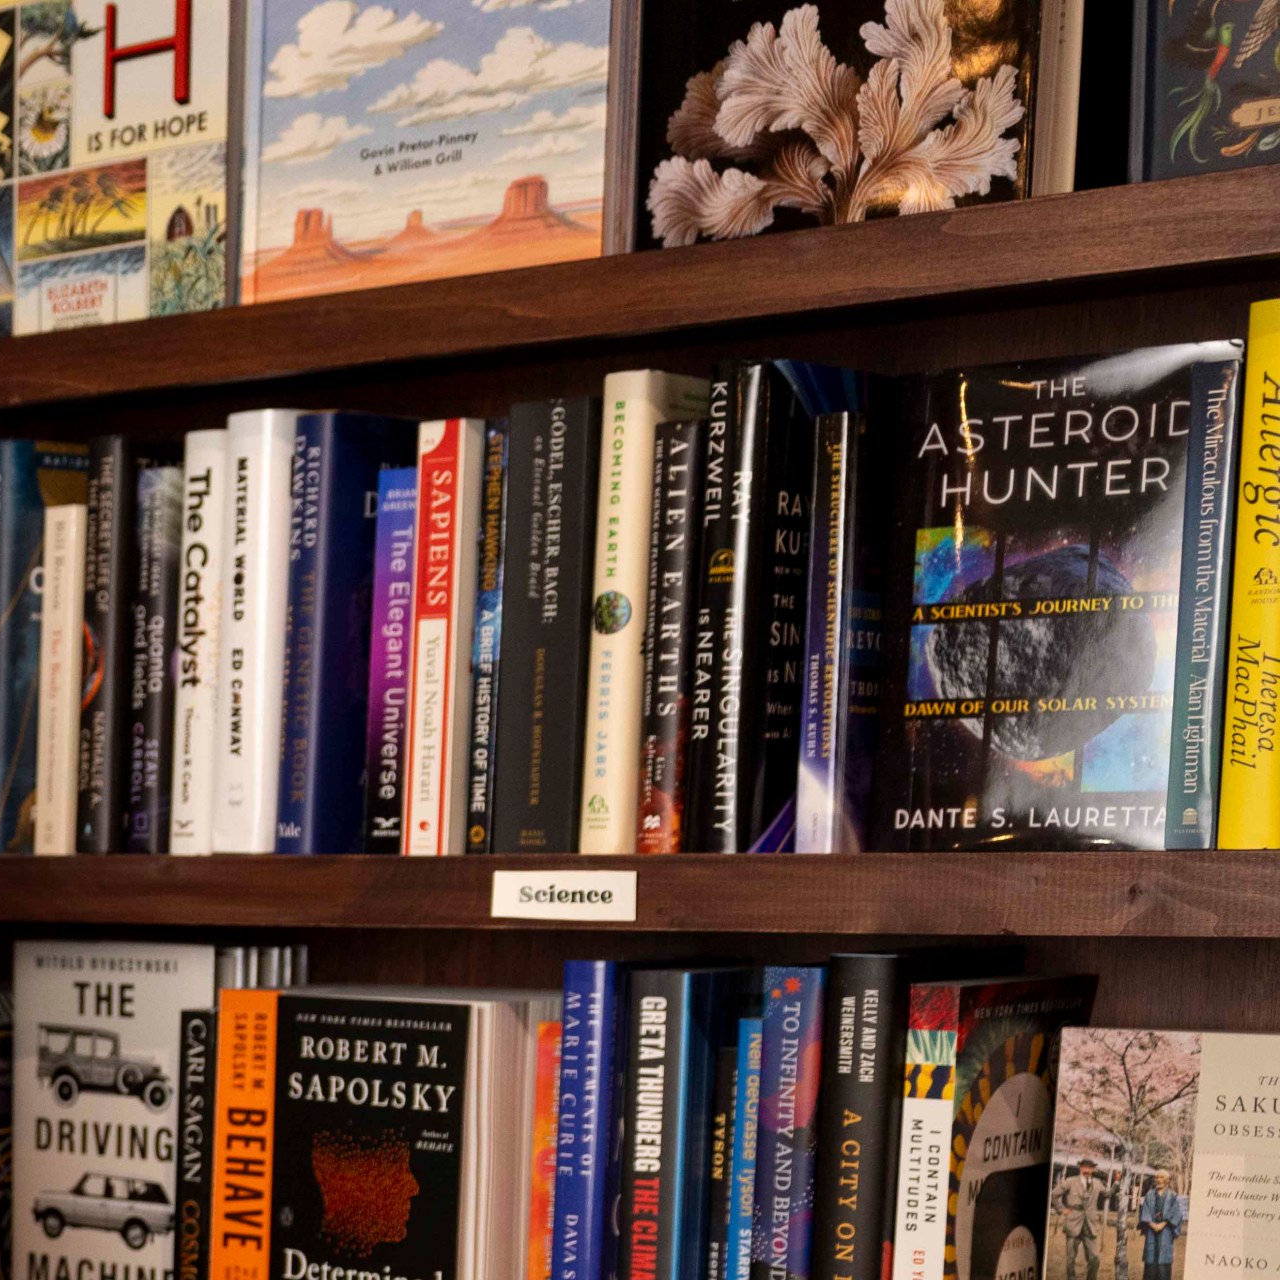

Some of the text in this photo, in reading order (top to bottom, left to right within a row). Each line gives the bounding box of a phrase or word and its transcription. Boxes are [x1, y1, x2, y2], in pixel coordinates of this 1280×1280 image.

[89, 112, 208, 152] IS FOR HOPE
[360, 130, 478, 161] Gavin Pretor-Pinney
[374, 150, 462, 175] & William Grill
[1033, 377, 1086, 400] THE
[705, 381, 729, 527] KURZWEIL
[942, 458, 1169, 509] HUNTER
[426, 469, 453, 607] SAPIENS
[656, 437, 690, 719] ALIEN EARTHS
[895, 805, 1167, 830] DANTE S. LAURETTA
[519, 885, 614, 905] Science
[73, 981, 135, 1018] THE
[639, 995, 667, 1057] GRETA
[300, 1035, 447, 1070] ROBERT M.
[288, 1072, 456, 1113] SAPOLSKY
[634, 1061, 665, 1173] THUNBERG
[36, 1117, 174, 1162] DRIVING
[222, 1107, 267, 1251] BEHAVE
[840, 1135, 860, 1212] CITY
[906, 1118, 924, 1233] MULTITUDES
[836, 1221, 856, 1263] ON
